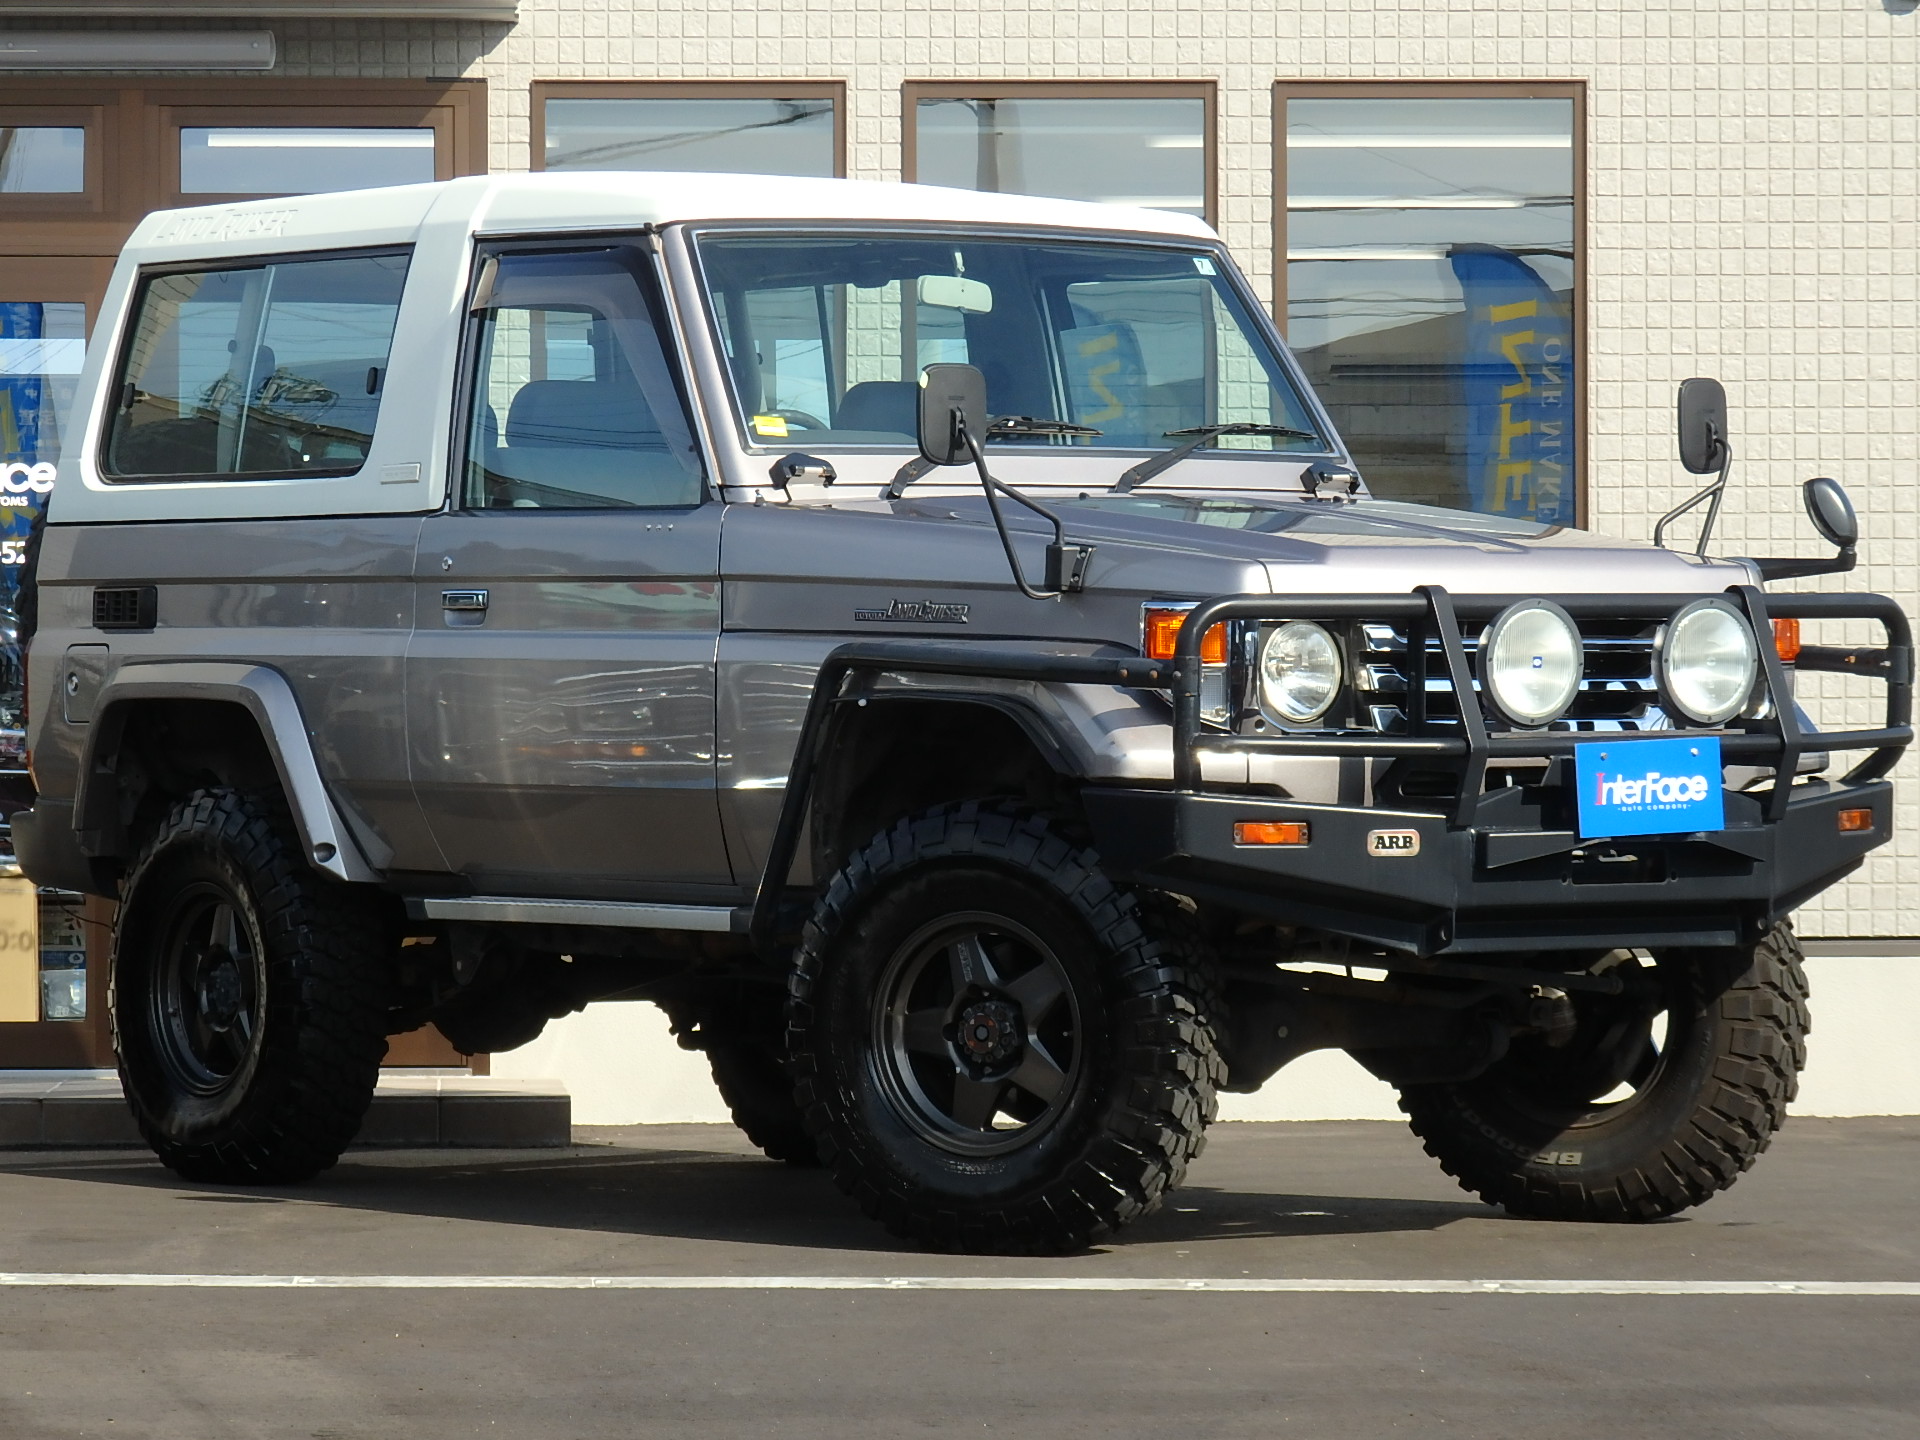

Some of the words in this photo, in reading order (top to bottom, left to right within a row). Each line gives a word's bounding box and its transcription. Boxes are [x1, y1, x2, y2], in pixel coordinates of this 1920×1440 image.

[0, 496, 29, 507] OMS
[1594, 772, 1708, 806] InterFace
[1374, 835, 1414, 850] ARB
